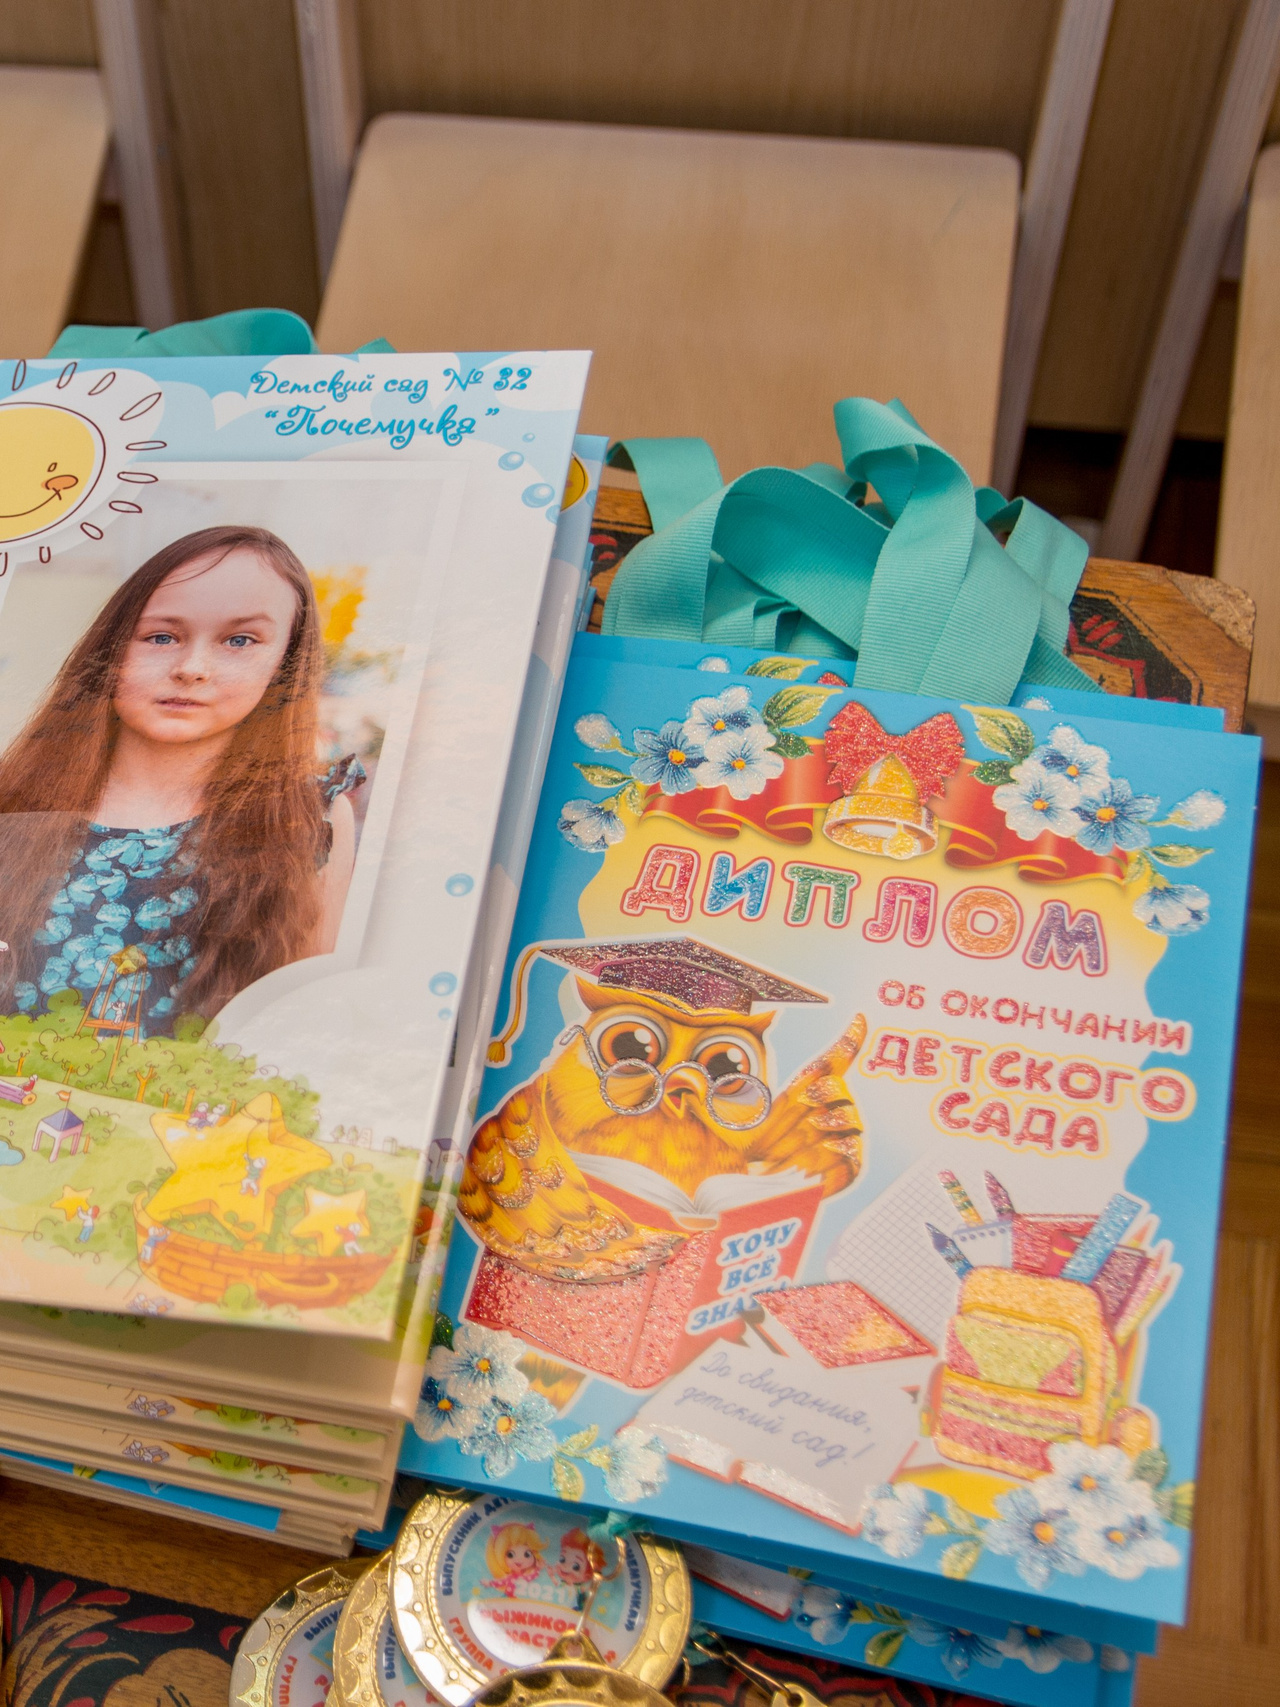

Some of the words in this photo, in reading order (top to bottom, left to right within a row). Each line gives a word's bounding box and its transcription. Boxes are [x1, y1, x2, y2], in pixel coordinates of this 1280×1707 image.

[250, 370, 375, 402] Детский
[383, 378, 429, 404] сад
[493, 367, 532, 391] 32
[622, 844, 1108, 977] ДИПЛОМ
[877, 979, 926, 1010] ОБ
[939, 989, 1187, 1050] ОКОНЧАНИИ
[866, 1034, 1187, 1114] ДЕТСКОГО
[937, 1091, 1100, 1152] САДА
[722, 1222, 796, 1262] ХОЧУ
[724, 1254, 776, 1291] ВСЁ
[674, 1386, 785, 1435] детский
[700, 1351, 732, 1378] До
[738, 1368, 872, 1433] свидания,
[442, 1512, 482, 1597] ВЫПУСКНИК
[514, 1581, 567, 1604] 2021
[448, 1617, 494, 1672] ГРУППА
[279, 1655, 298, 1707] ГРУПП
